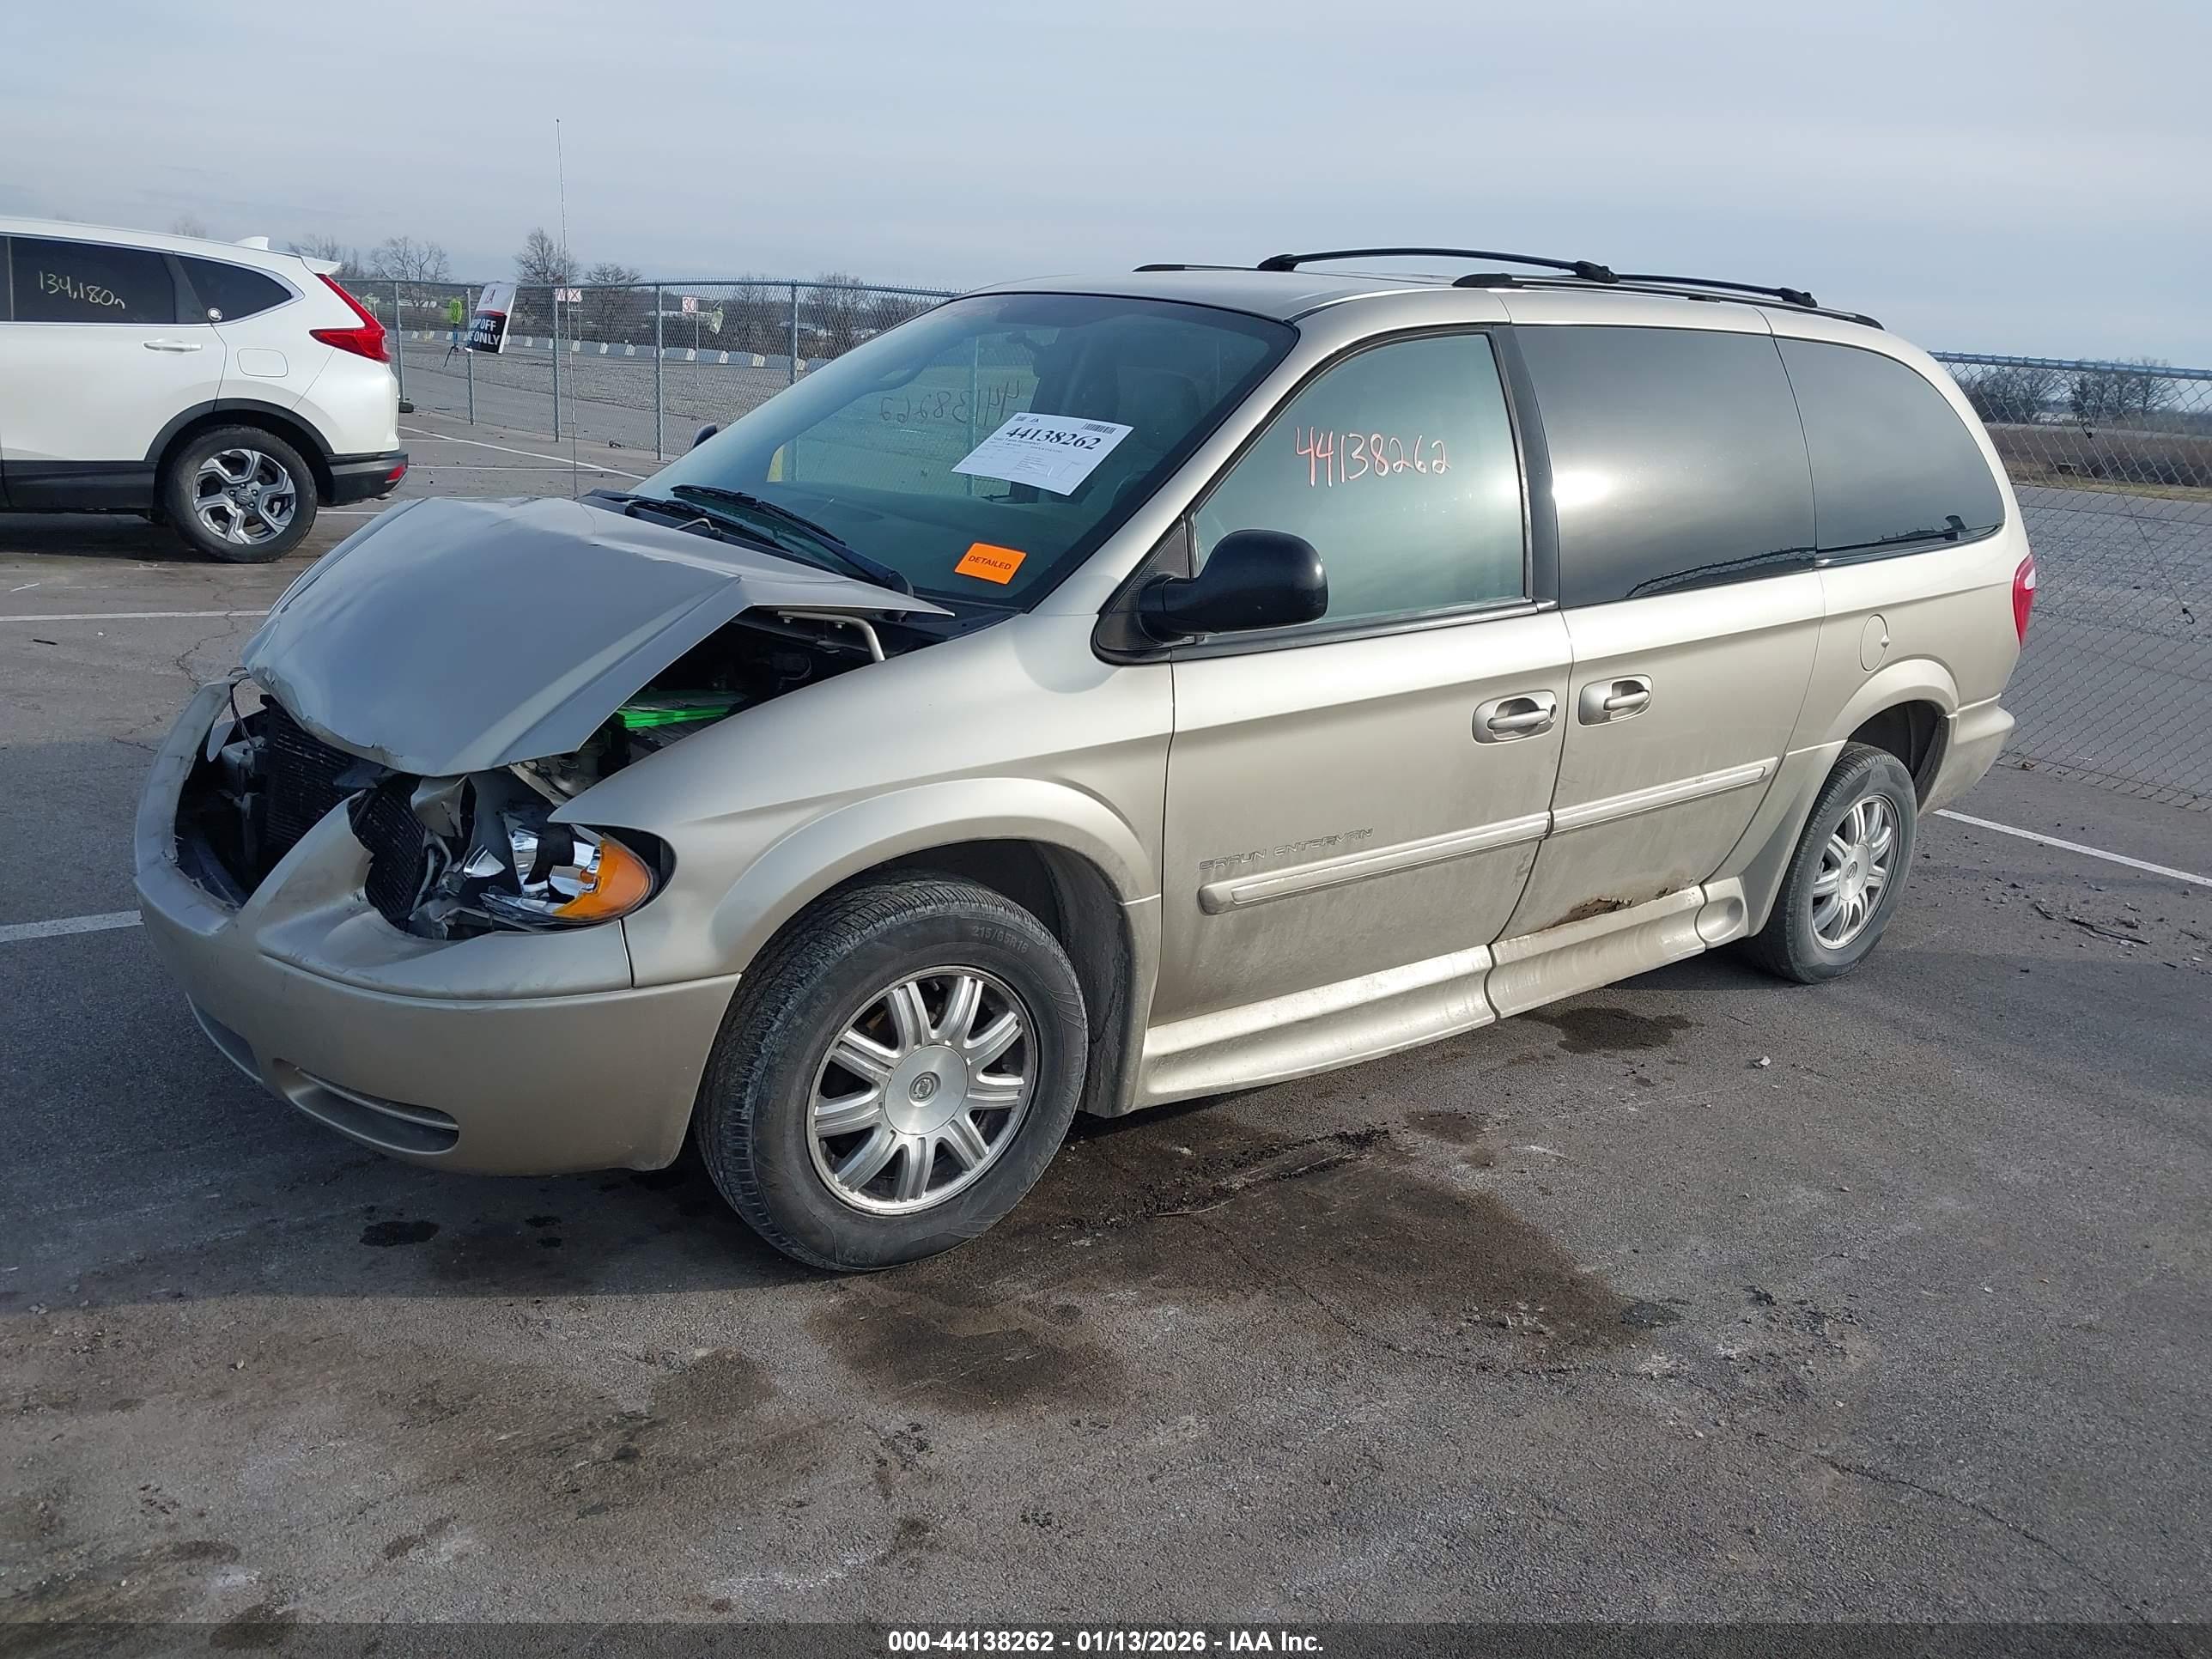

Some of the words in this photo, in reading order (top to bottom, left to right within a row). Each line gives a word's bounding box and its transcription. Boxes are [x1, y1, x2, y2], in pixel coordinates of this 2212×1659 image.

[480, 319, 496, 331] OFF
[473, 331, 501, 345] ONLY
[1006, 426, 1103, 451] 44138262
[1295, 426, 1450, 487] 44138262
[969, 556, 1012, 570] DETAILED
[1199, 848, 1267, 872] BRAUN
[1273, 828, 1373, 856] ENTERVAN
